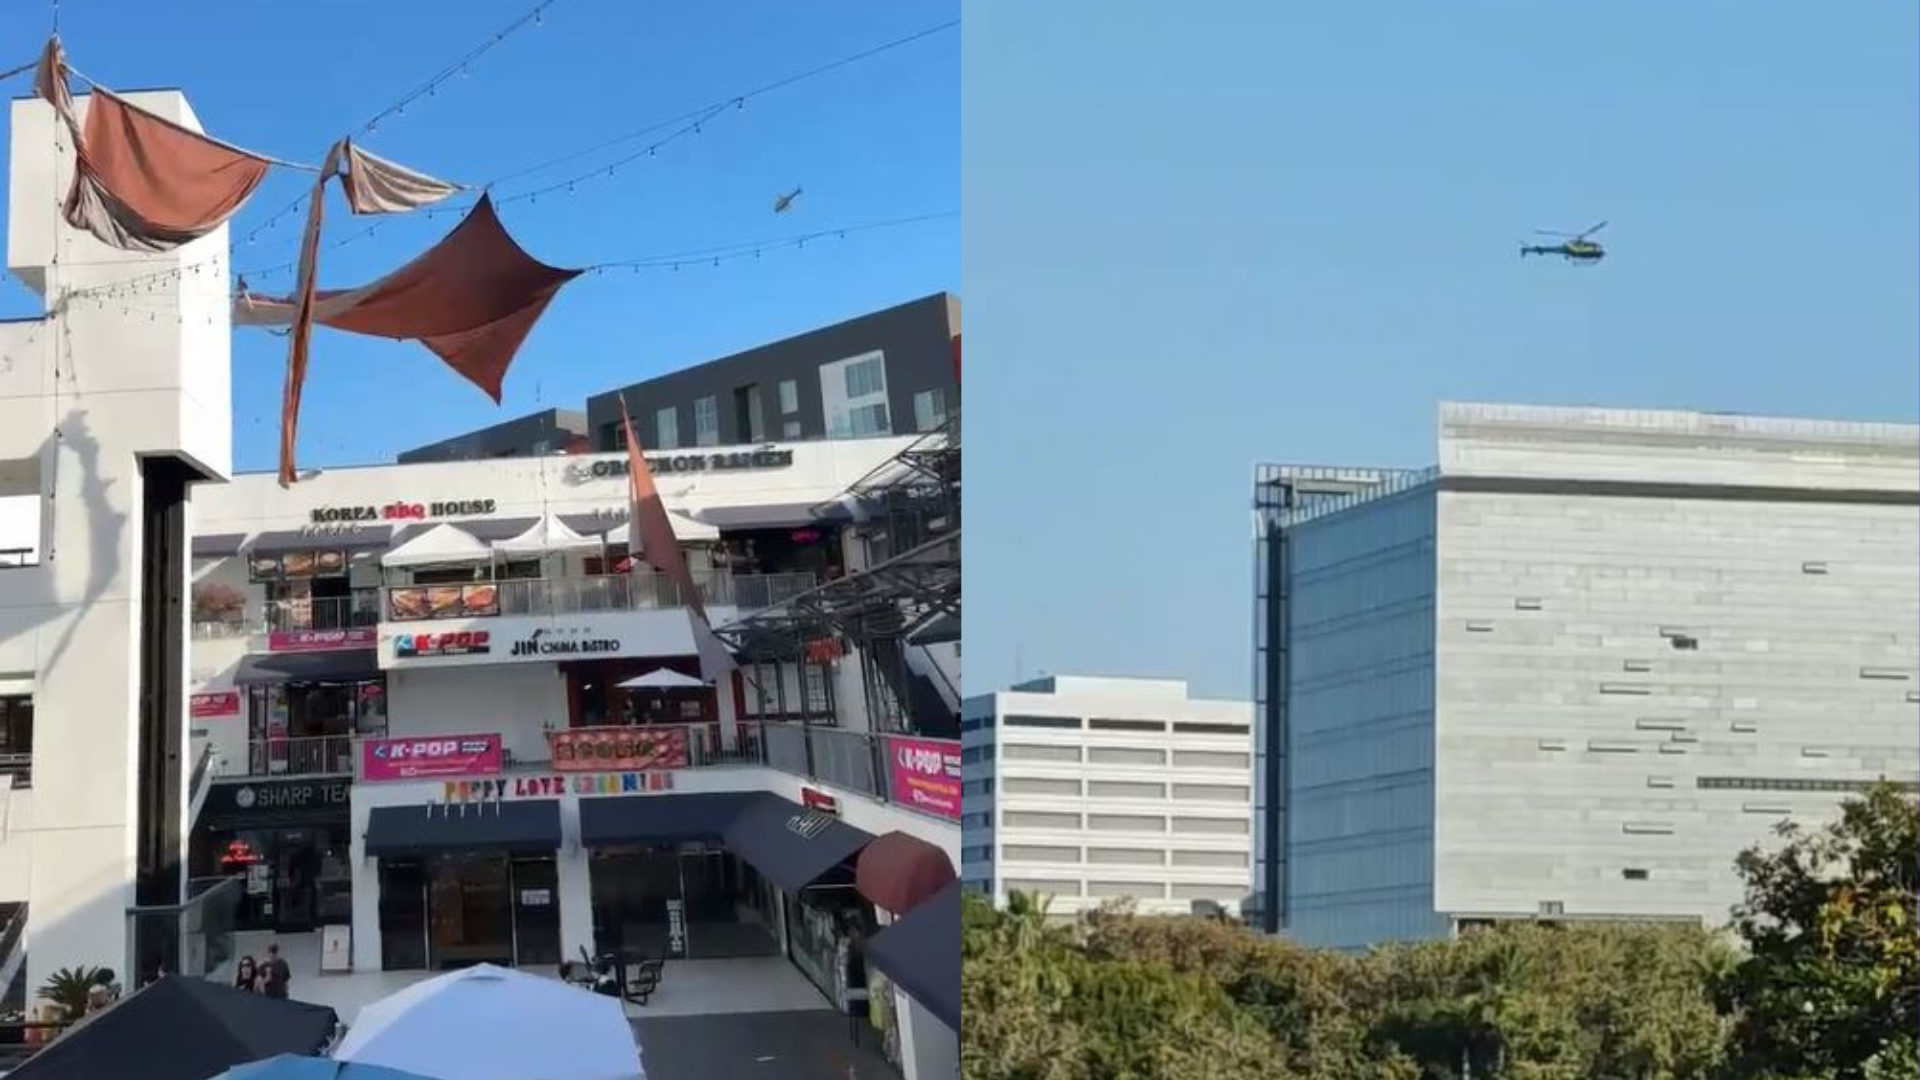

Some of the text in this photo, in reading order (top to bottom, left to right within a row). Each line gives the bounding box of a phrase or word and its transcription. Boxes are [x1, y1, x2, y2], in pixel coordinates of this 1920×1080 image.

[711, 449, 794, 470] RAMEN
[311, 498, 496, 522] KOREA BBQ HOUSE
[414, 630, 491, 651] K-POP
[511, 632, 622, 656] JIN CHINA BISTRO
[390, 740, 458, 758] K-POP
[902, 746, 942, 775] K-POP
[258, 785, 314, 807] SHARP
[516, 776, 566, 796] LOVE
